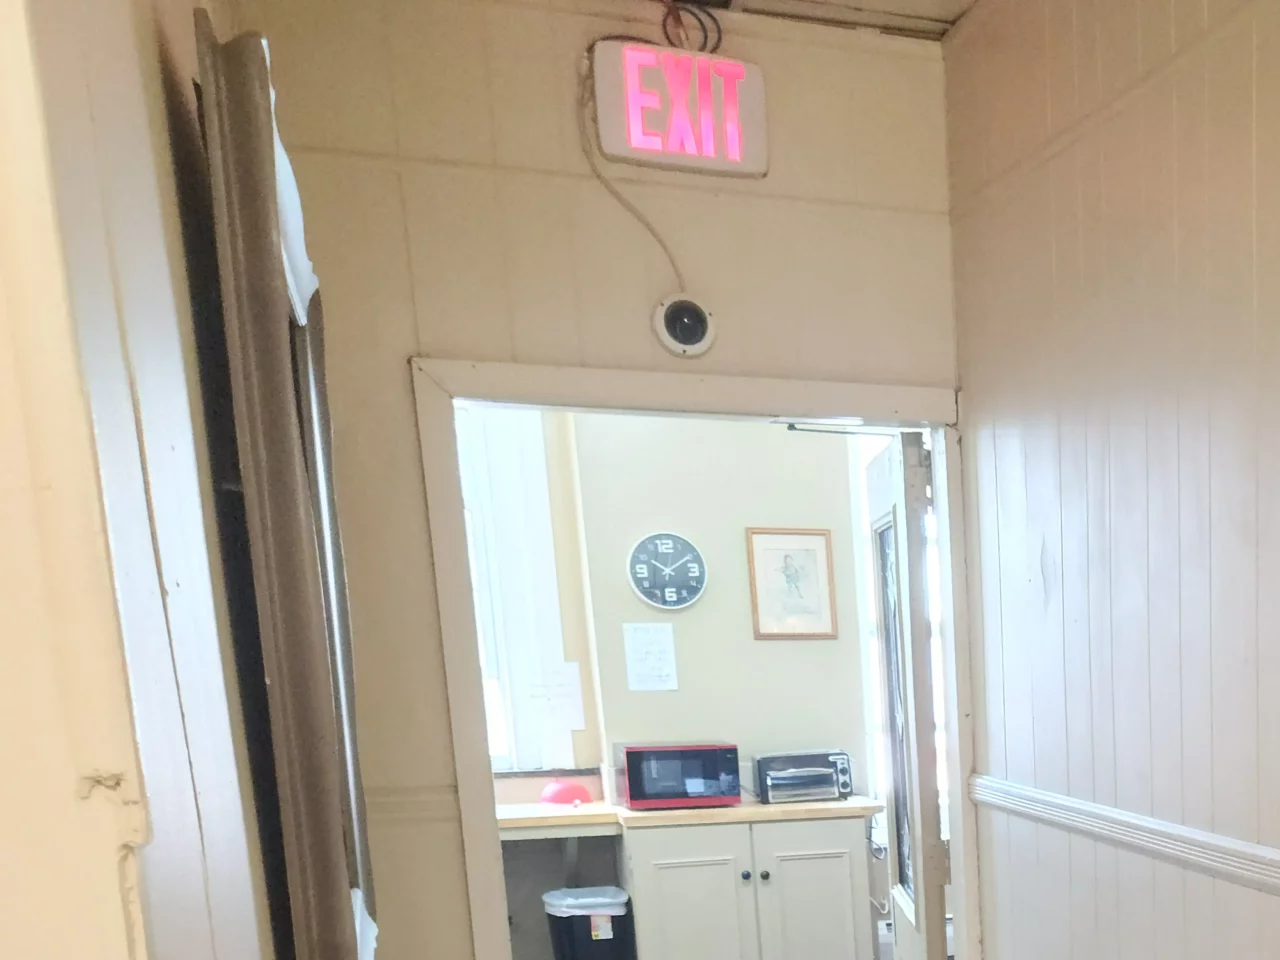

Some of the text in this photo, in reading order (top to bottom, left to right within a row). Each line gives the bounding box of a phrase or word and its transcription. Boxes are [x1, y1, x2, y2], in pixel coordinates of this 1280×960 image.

[622, 46, 745, 162] EXIT
[655, 540, 674, 553] 12
[636, 564, 648, 577] 9
[687, 563, 700, 577] 3
[664, 588, 677, 601] 6
